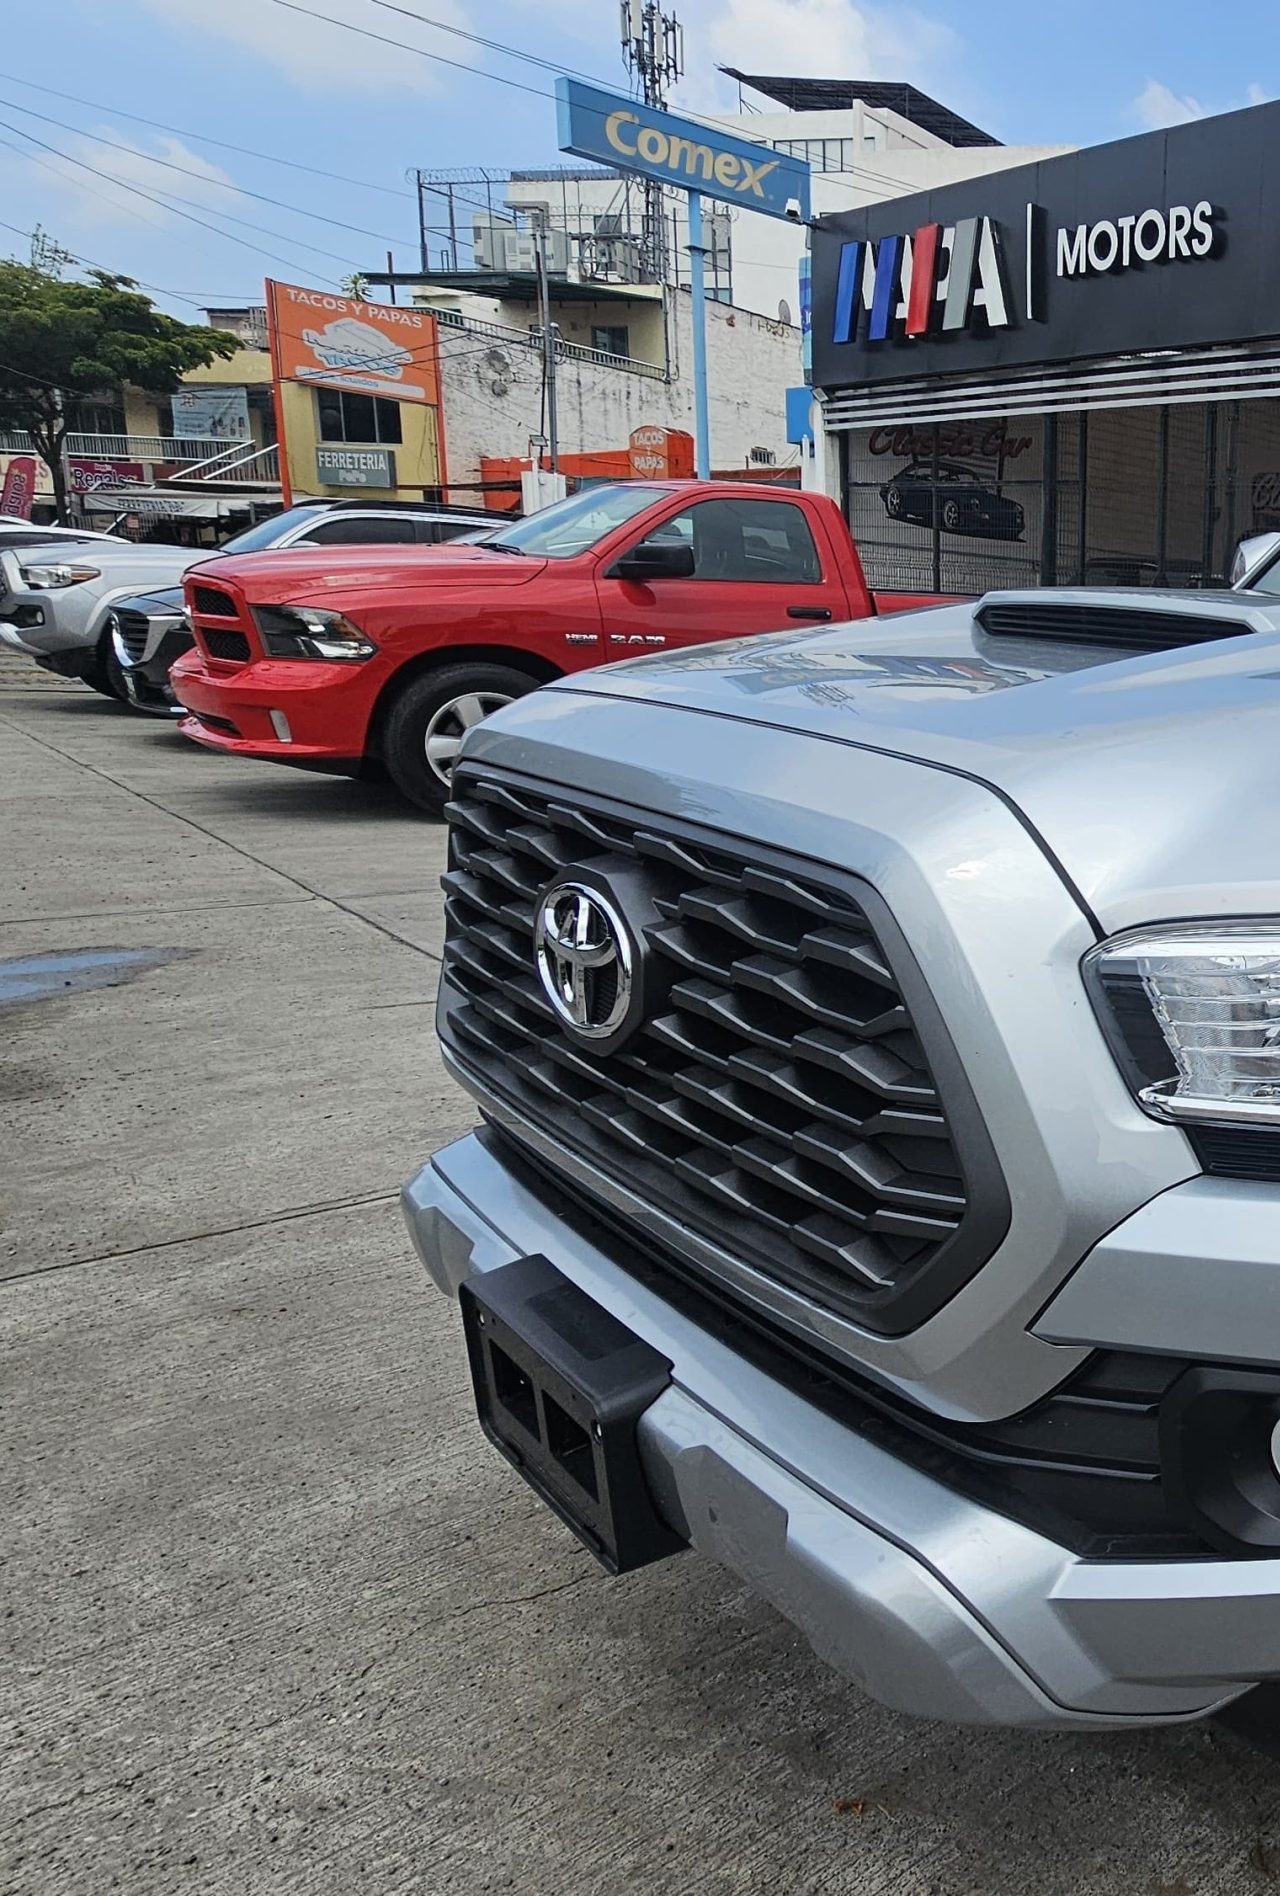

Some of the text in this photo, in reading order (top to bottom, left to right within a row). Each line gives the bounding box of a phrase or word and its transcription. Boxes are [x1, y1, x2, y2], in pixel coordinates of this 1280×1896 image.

[605, 111, 779, 198] Comex
[1056, 200, 1214, 278] MOTORS
[287, 288, 423, 329] TACOS Y PAPAS
[632, 431, 665, 446] TACOS
[317, 451, 387, 471] FERRETERIA
[633, 456, 665, 470] PAPAS
